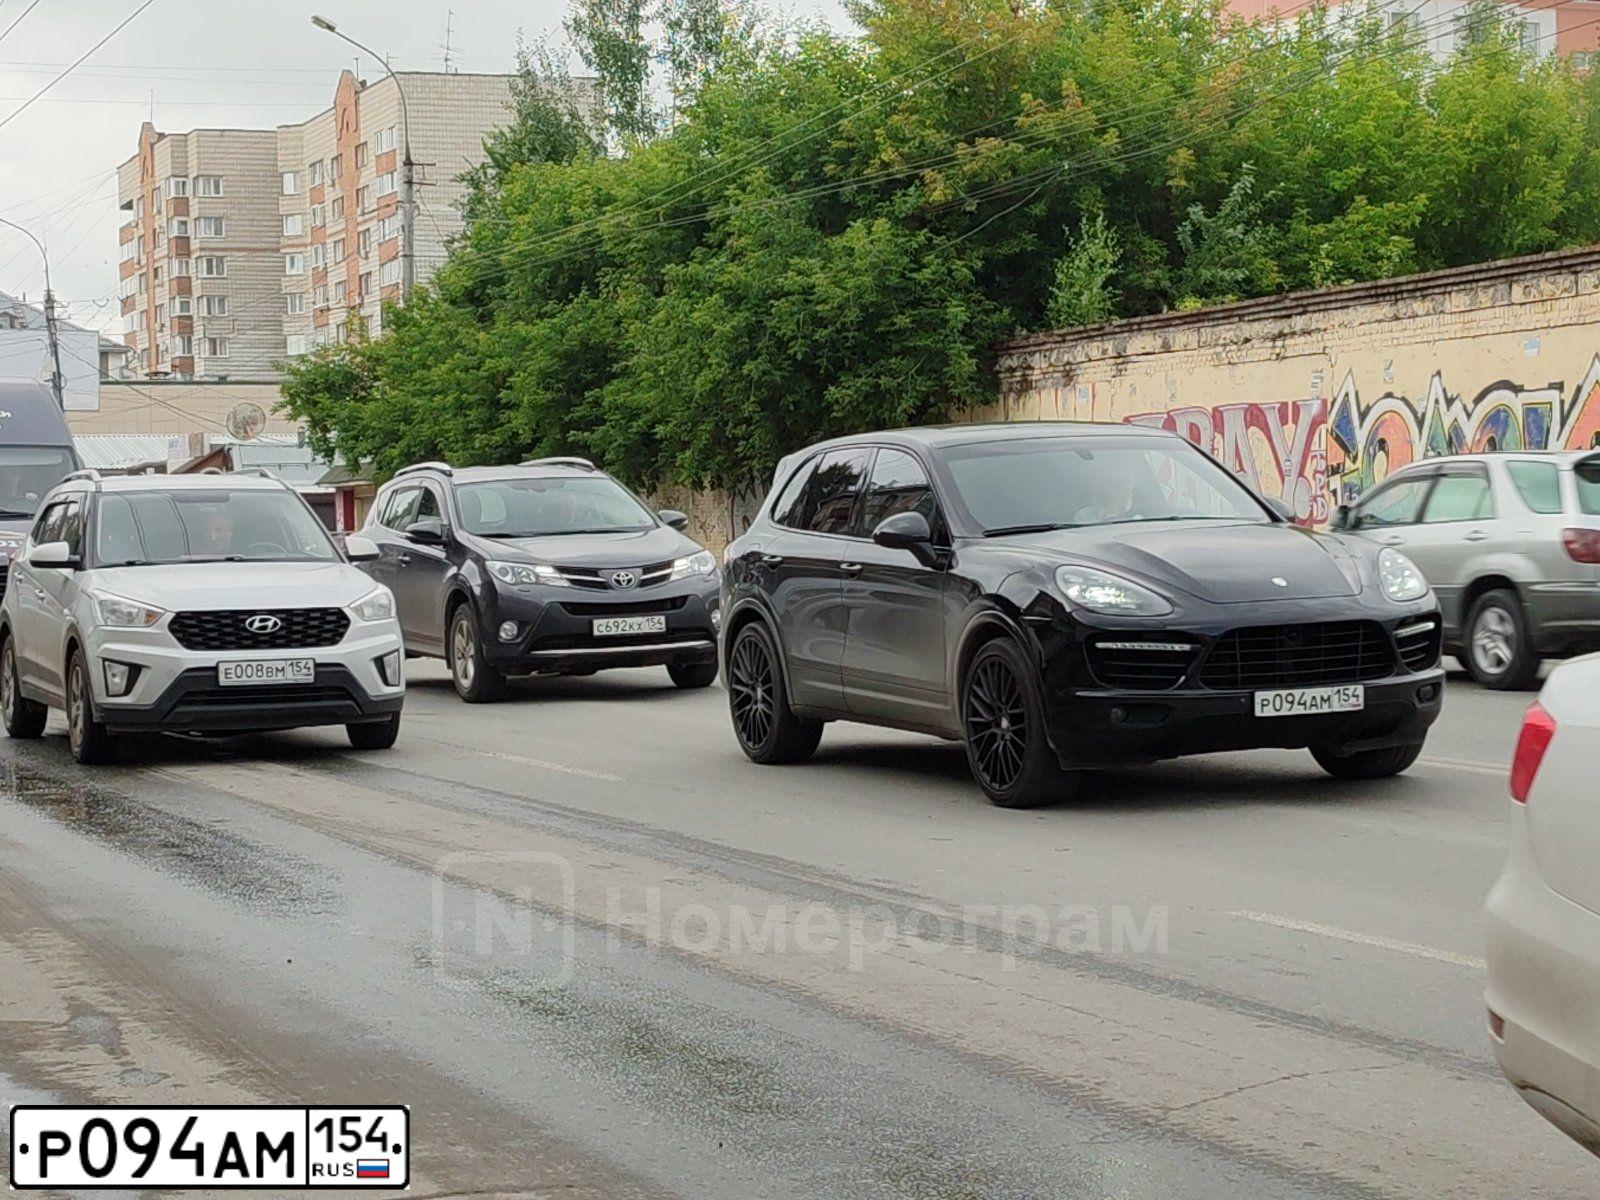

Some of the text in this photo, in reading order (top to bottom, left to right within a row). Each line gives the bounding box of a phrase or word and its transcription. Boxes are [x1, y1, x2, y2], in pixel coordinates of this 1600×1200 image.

[288, 661, 311, 674] 154
[1260, 686, 1360, 714] Р094АМ 154
